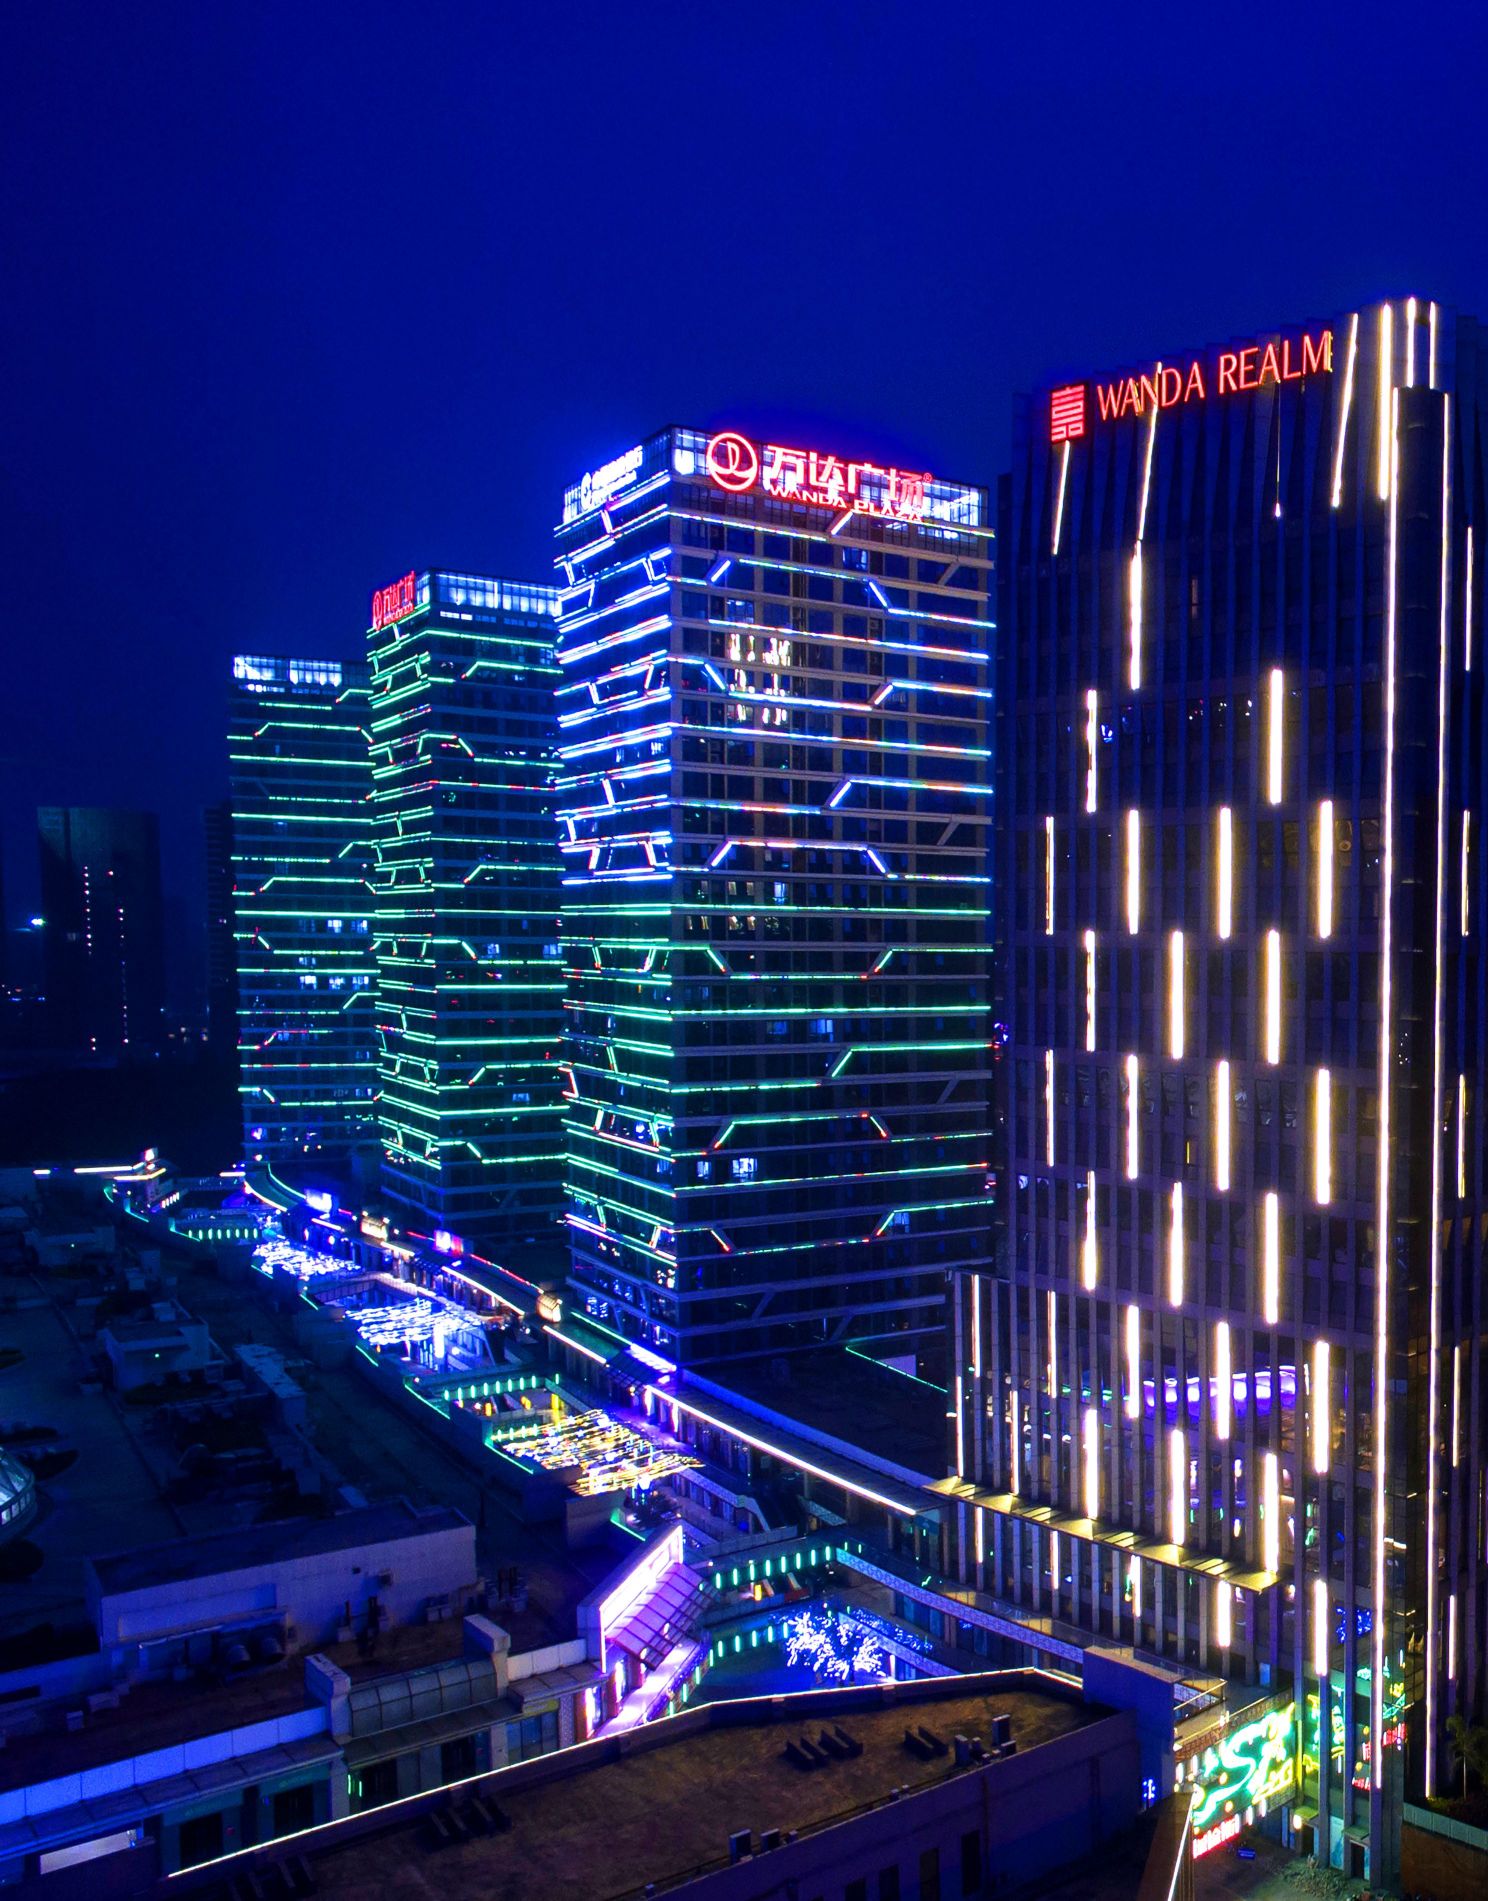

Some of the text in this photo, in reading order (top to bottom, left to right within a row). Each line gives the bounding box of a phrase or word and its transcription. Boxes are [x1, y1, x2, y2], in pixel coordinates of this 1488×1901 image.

[1097, 330, 1333, 421] WANDA REALM
[767, 444, 925, 506] 万达广场
[769, 485, 923, 522] WANDA PLAZA
